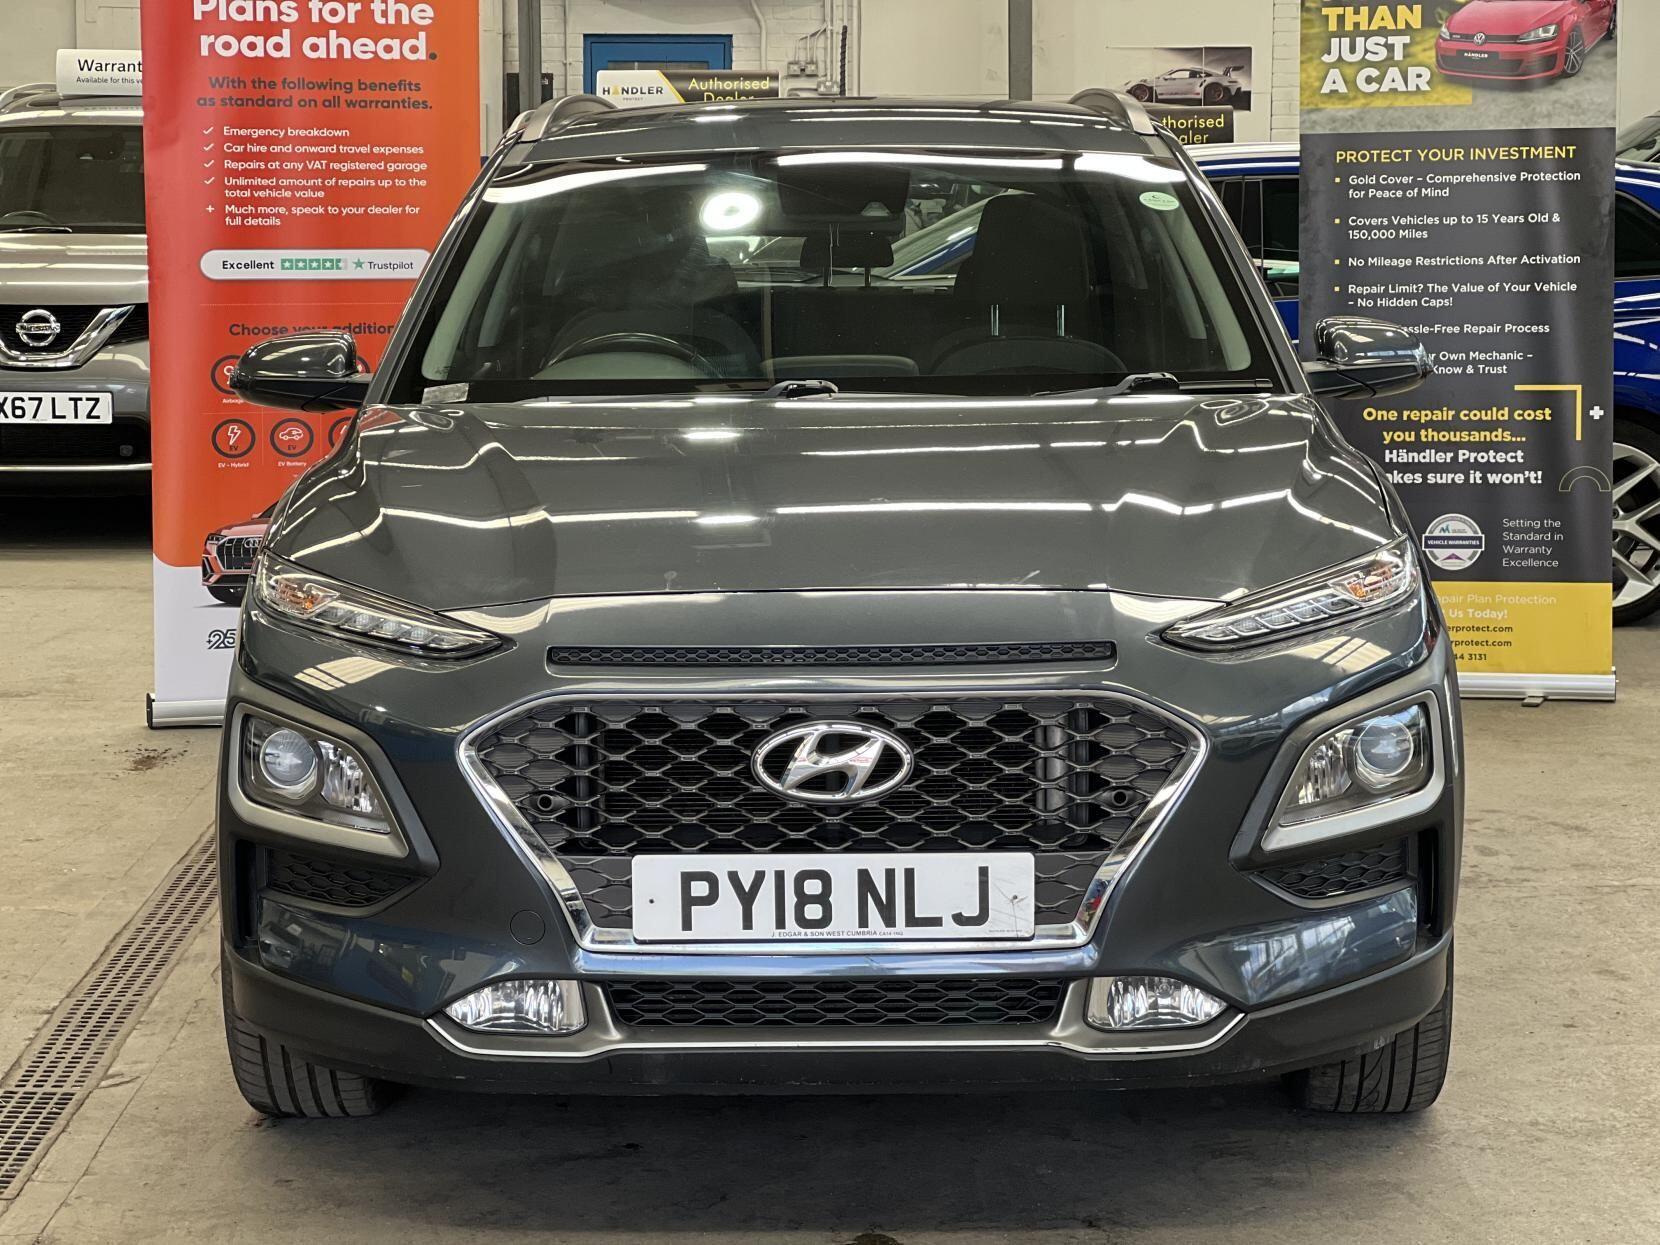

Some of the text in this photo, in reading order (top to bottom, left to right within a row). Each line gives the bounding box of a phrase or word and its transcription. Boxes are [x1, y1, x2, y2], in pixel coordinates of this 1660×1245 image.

[193, 0, 434, 25] Plans for the
[1321, 4, 1422, 31] THAN
[201, 29, 436, 60] road ahead.
[1321, 35, 1410, 63] JUST
[78, 59, 142, 72] Warrant
[208, 76, 421, 94] With the following benefits
[688, 77, 770, 90] Authorised
[1321, 66, 1431, 94] A CAR
[196, 95, 432, 109] as standard on all warranties.
[224, 126, 349, 138] Emergency breakdown
[224, 143, 423, 155] Car hire and onward travel expenses
[1337, 146, 1576, 163] PROTECT YOUR INVESTMENT
[224, 160, 265, 171] Repairs
[283, 163, 304, 171] any
[306, 161, 327, 169] VAT
[330, 161, 384, 172] registered
[387, 163, 427, 172] garage
[225, 177, 276, 186] Unlimited
[339, 178, 375, 188] repairs
[1349, 171, 1580, 184] Gold Cover Comprehensive Protection
[225, 189, 324, 197] total vehicle value
[1349, 188, 1449, 198] for Peace of Mind
[226, 205, 255, 213] Much
[292, 206, 324, 216] speak
[342, 207, 365, 216] your
[368, 205, 402, 214] dealer
[406, 205, 420, 213] for
[225, 216, 280, 225] full details
[1349, 213, 1560, 226] Covers Vehicles up to 15 Years Old &
[1349, 229, 1428, 240] 150,000 Miles
[223, 260, 274, 269] Excellent
[368, 262, 413, 271] Trustpilot
[1349, 255, 1580, 267] No Mileage Restrictions After Activation
[1349, 282, 1577, 295] Repair Limit? The Value of Your Vehicle
[1358, 297, 1452, 308] No Hidden Caps!
[229, 324, 288, 336] Choose
[1464, 324, 1501, 334] Repair
[1505, 324, 1550, 332] Process
[1440, 352, 1465, 360] Own
[1470, 351, 1523, 360] Mechanic
[1466, 365, 1474, 373] &
[1478, 365, 1507, 373] Trust
[52, 398, 100, 419] LTZ
[1363, 407, 1551, 423] One repair could cost
[1383, 432, 1415, 444] you
[1385, 450, 1524, 462] Händler Protect
[1428, 474, 1464, 483] sure
[1470, 471, 1482, 483] it
[1503, 519, 1560, 528] Setting the
[1503, 532, 1550, 540] Standard
[1503, 546, 1552, 555] Warranty
[1503, 558, 1558, 567] Excellence
[1467, 594, 1492, 603] Plan
[1496, 595, 1556, 604] Protection
[1450, 609, 1507, 620] Us Today!
[681, 866, 989, 931] PY18 NLJ
